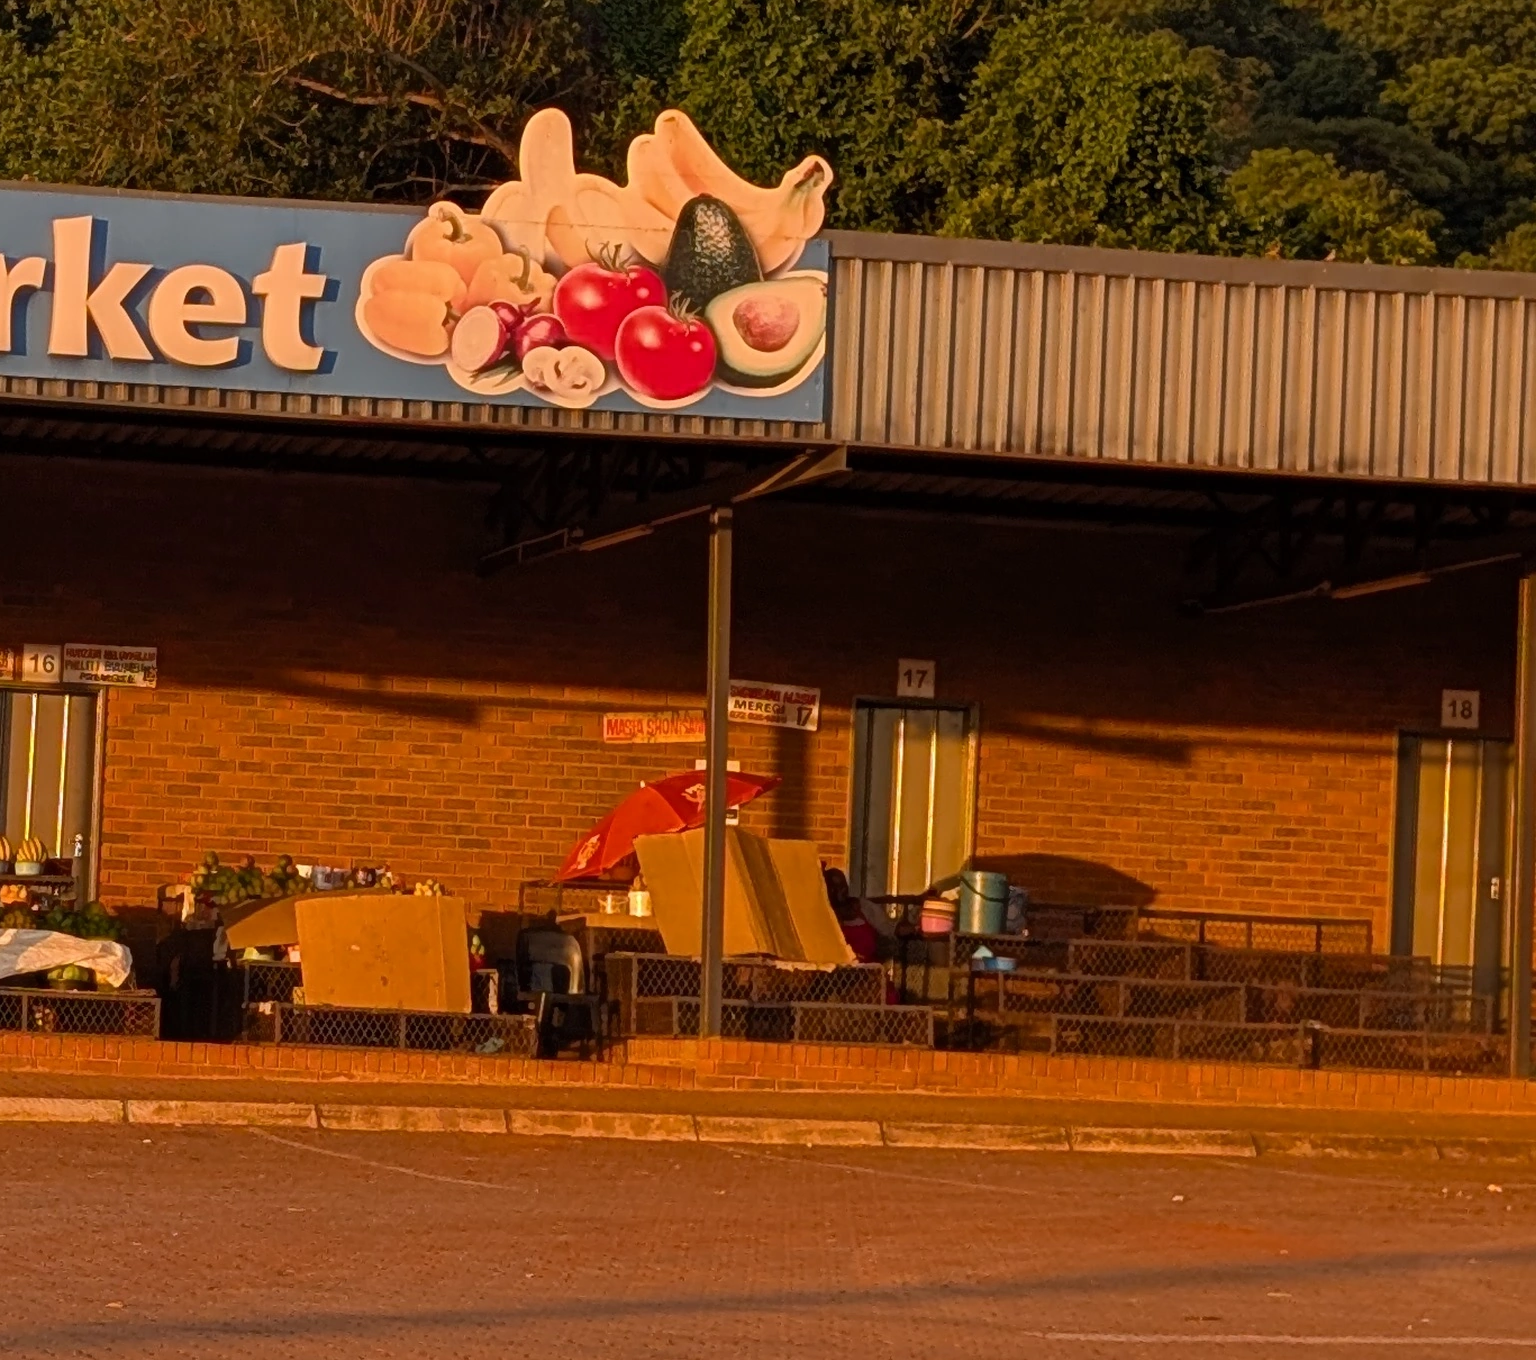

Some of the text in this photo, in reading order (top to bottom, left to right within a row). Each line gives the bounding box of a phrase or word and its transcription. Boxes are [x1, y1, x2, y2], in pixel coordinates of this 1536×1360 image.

[30, 653, 56, 673] 16
[903, 668, 928, 689] 17
[796, 706, 813, 726] 17
[1448, 699, 1473, 720] 18
